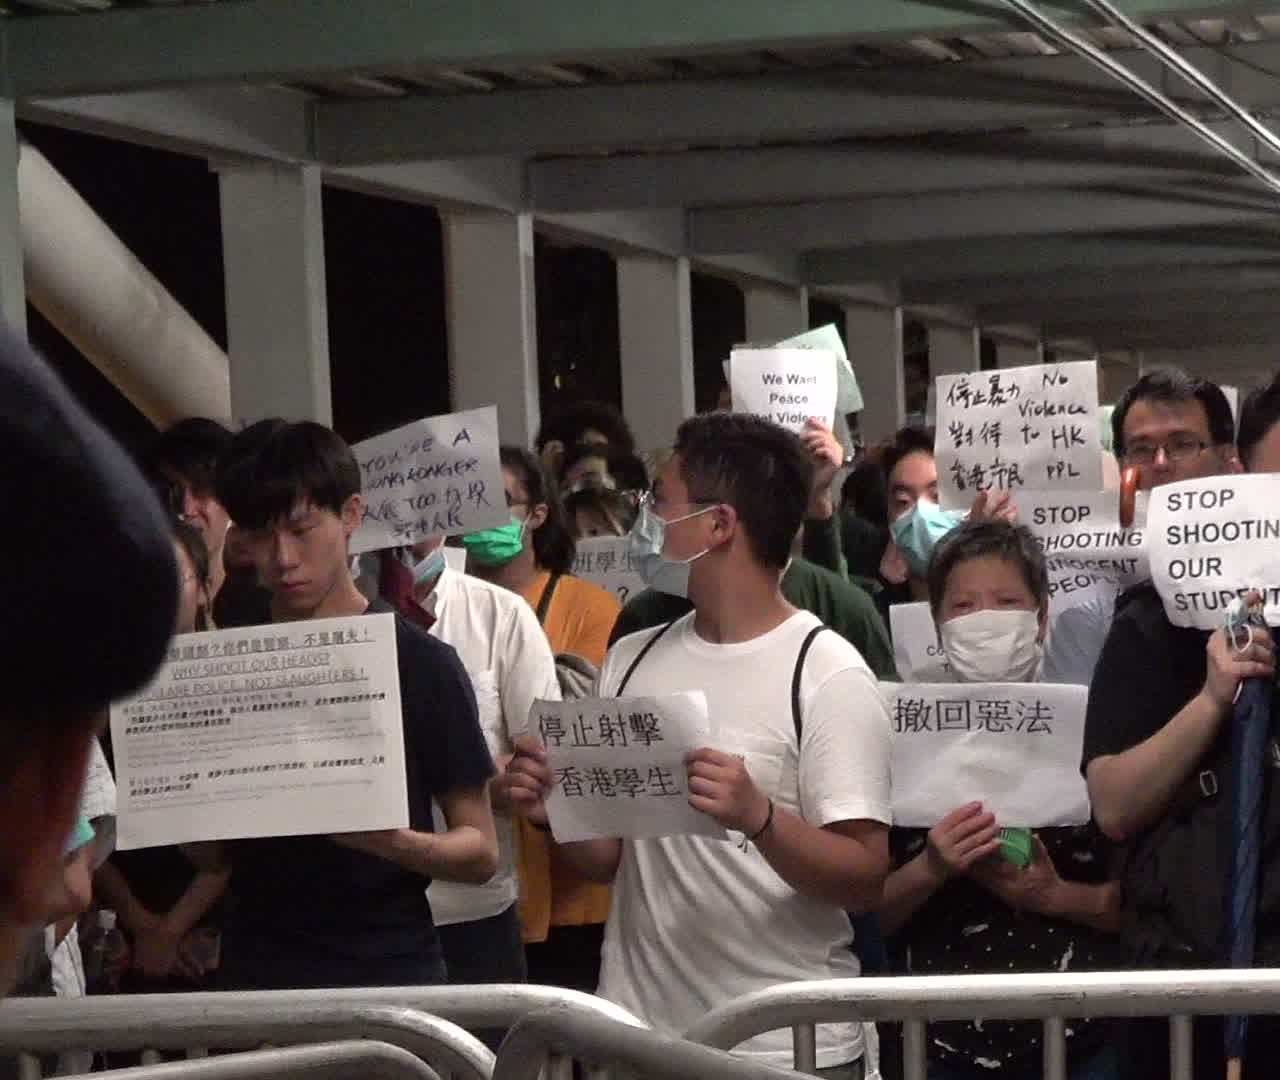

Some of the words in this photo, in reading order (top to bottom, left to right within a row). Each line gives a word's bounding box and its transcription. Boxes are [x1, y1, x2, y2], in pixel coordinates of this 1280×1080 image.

[762, 373, 783, 385] We
[786, 373, 817, 385] Want
[768, 393, 809, 405] Peace
[946, 374, 1020, 408] 停止暴力
[1019, 398, 1088, 418] Violence
[1051, 425, 1085, 448] HK
[1166, 489, 1235, 511] STOP
[1032, 505, 1091, 525] STOP
[1168, 557, 1222, 580] OUR
[894, 699, 1054, 734] 撤回惡法
[539, 713, 663, 747] 停止射擊
[557, 766, 684, 799] 香港學生
